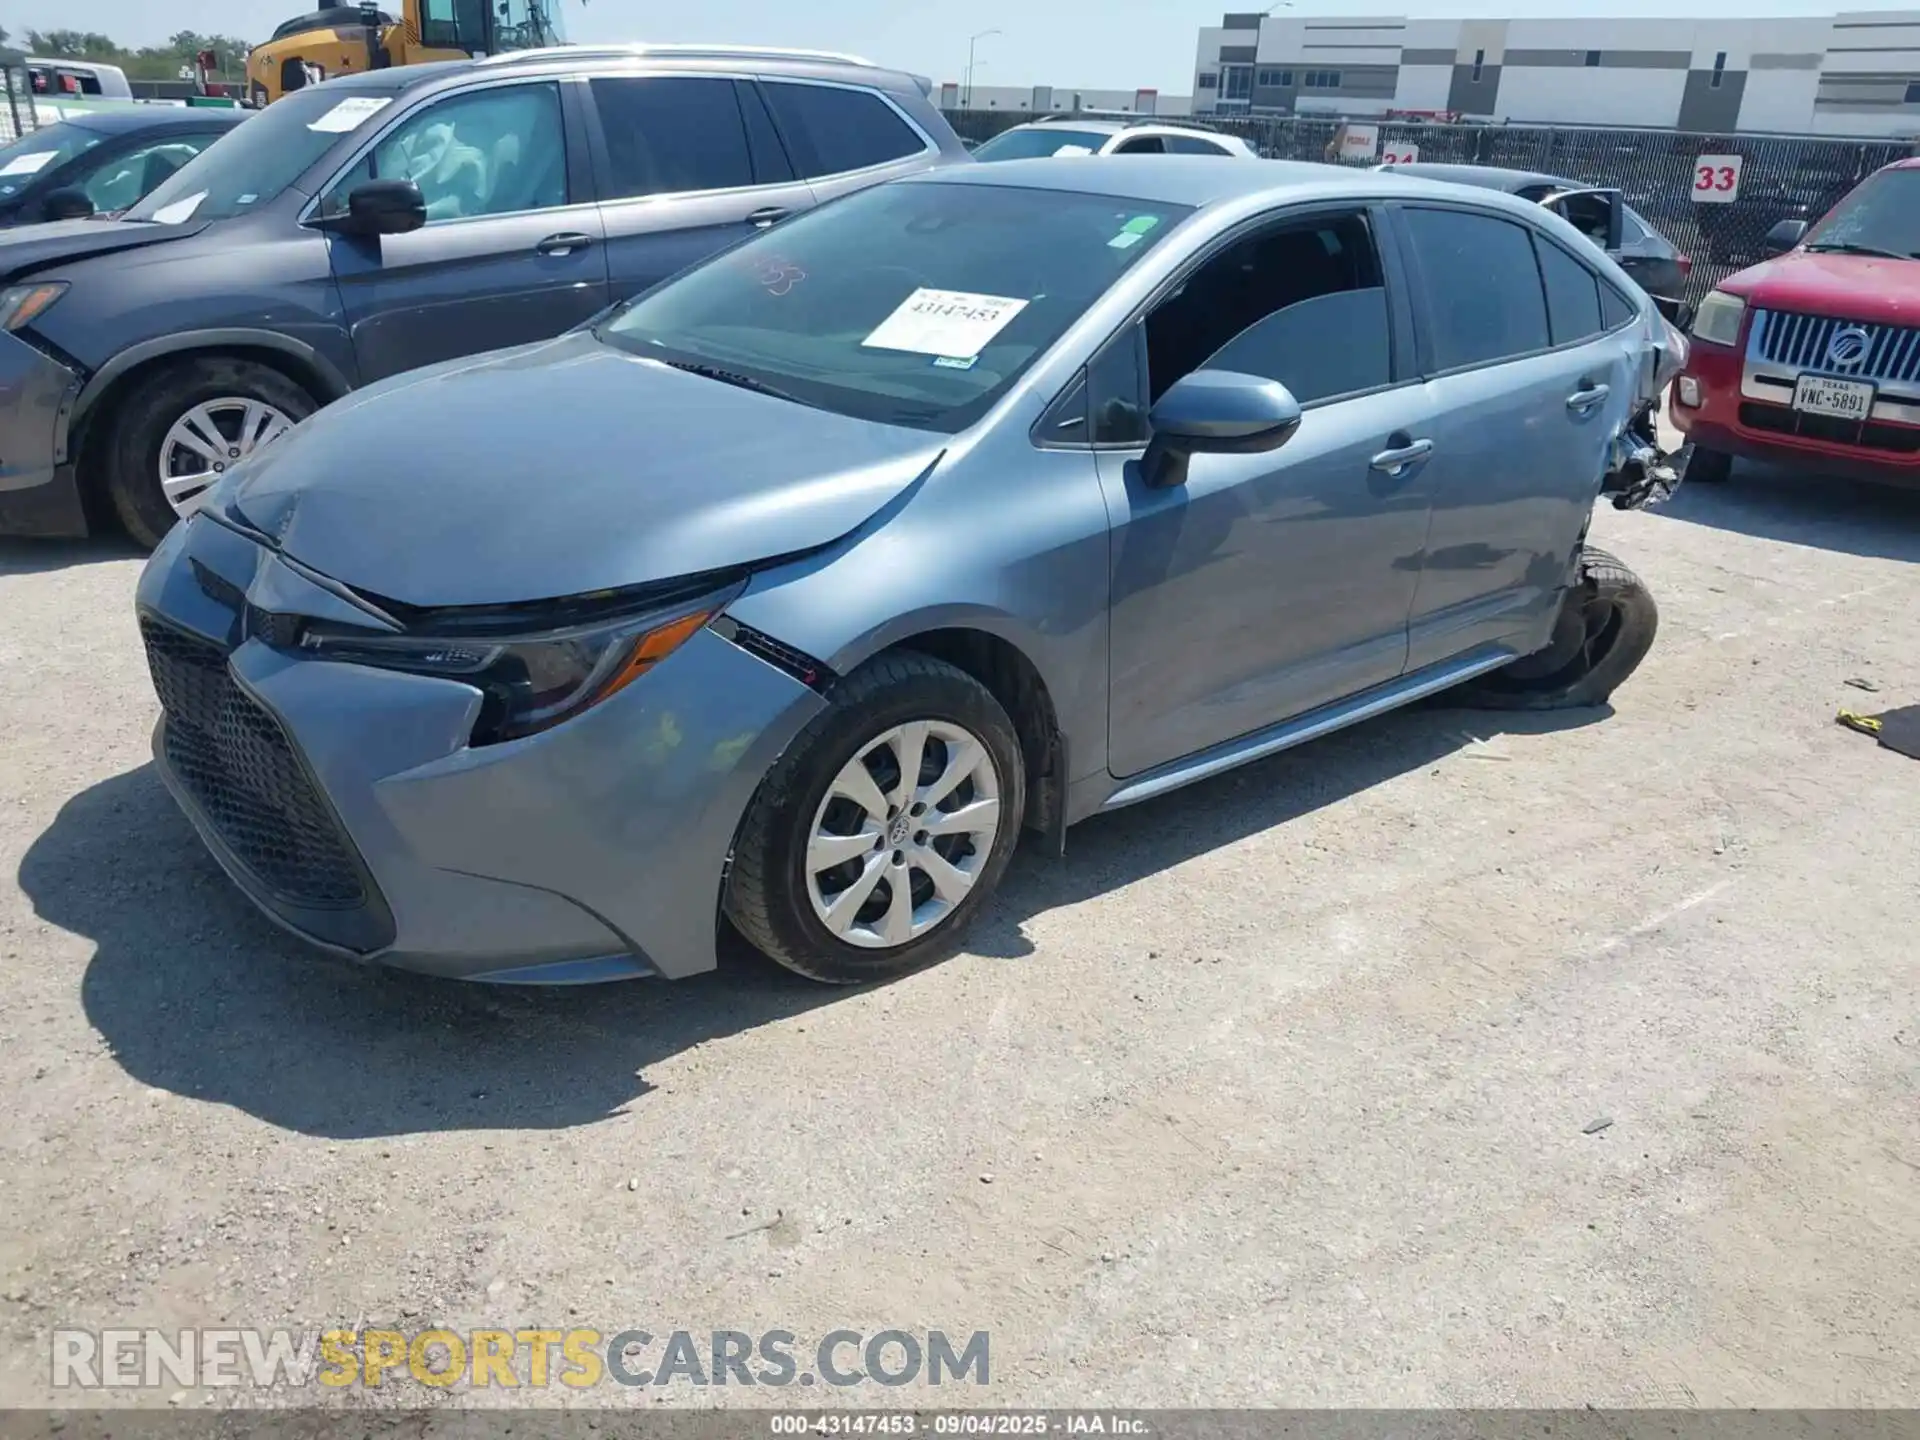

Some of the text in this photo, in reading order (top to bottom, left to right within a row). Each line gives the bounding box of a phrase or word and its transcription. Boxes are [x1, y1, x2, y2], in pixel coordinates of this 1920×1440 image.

[1695, 166, 1735, 191] 33
[911, 301, 1000, 322] 43147453
[1822, 379, 1849, 390] TEXAS
